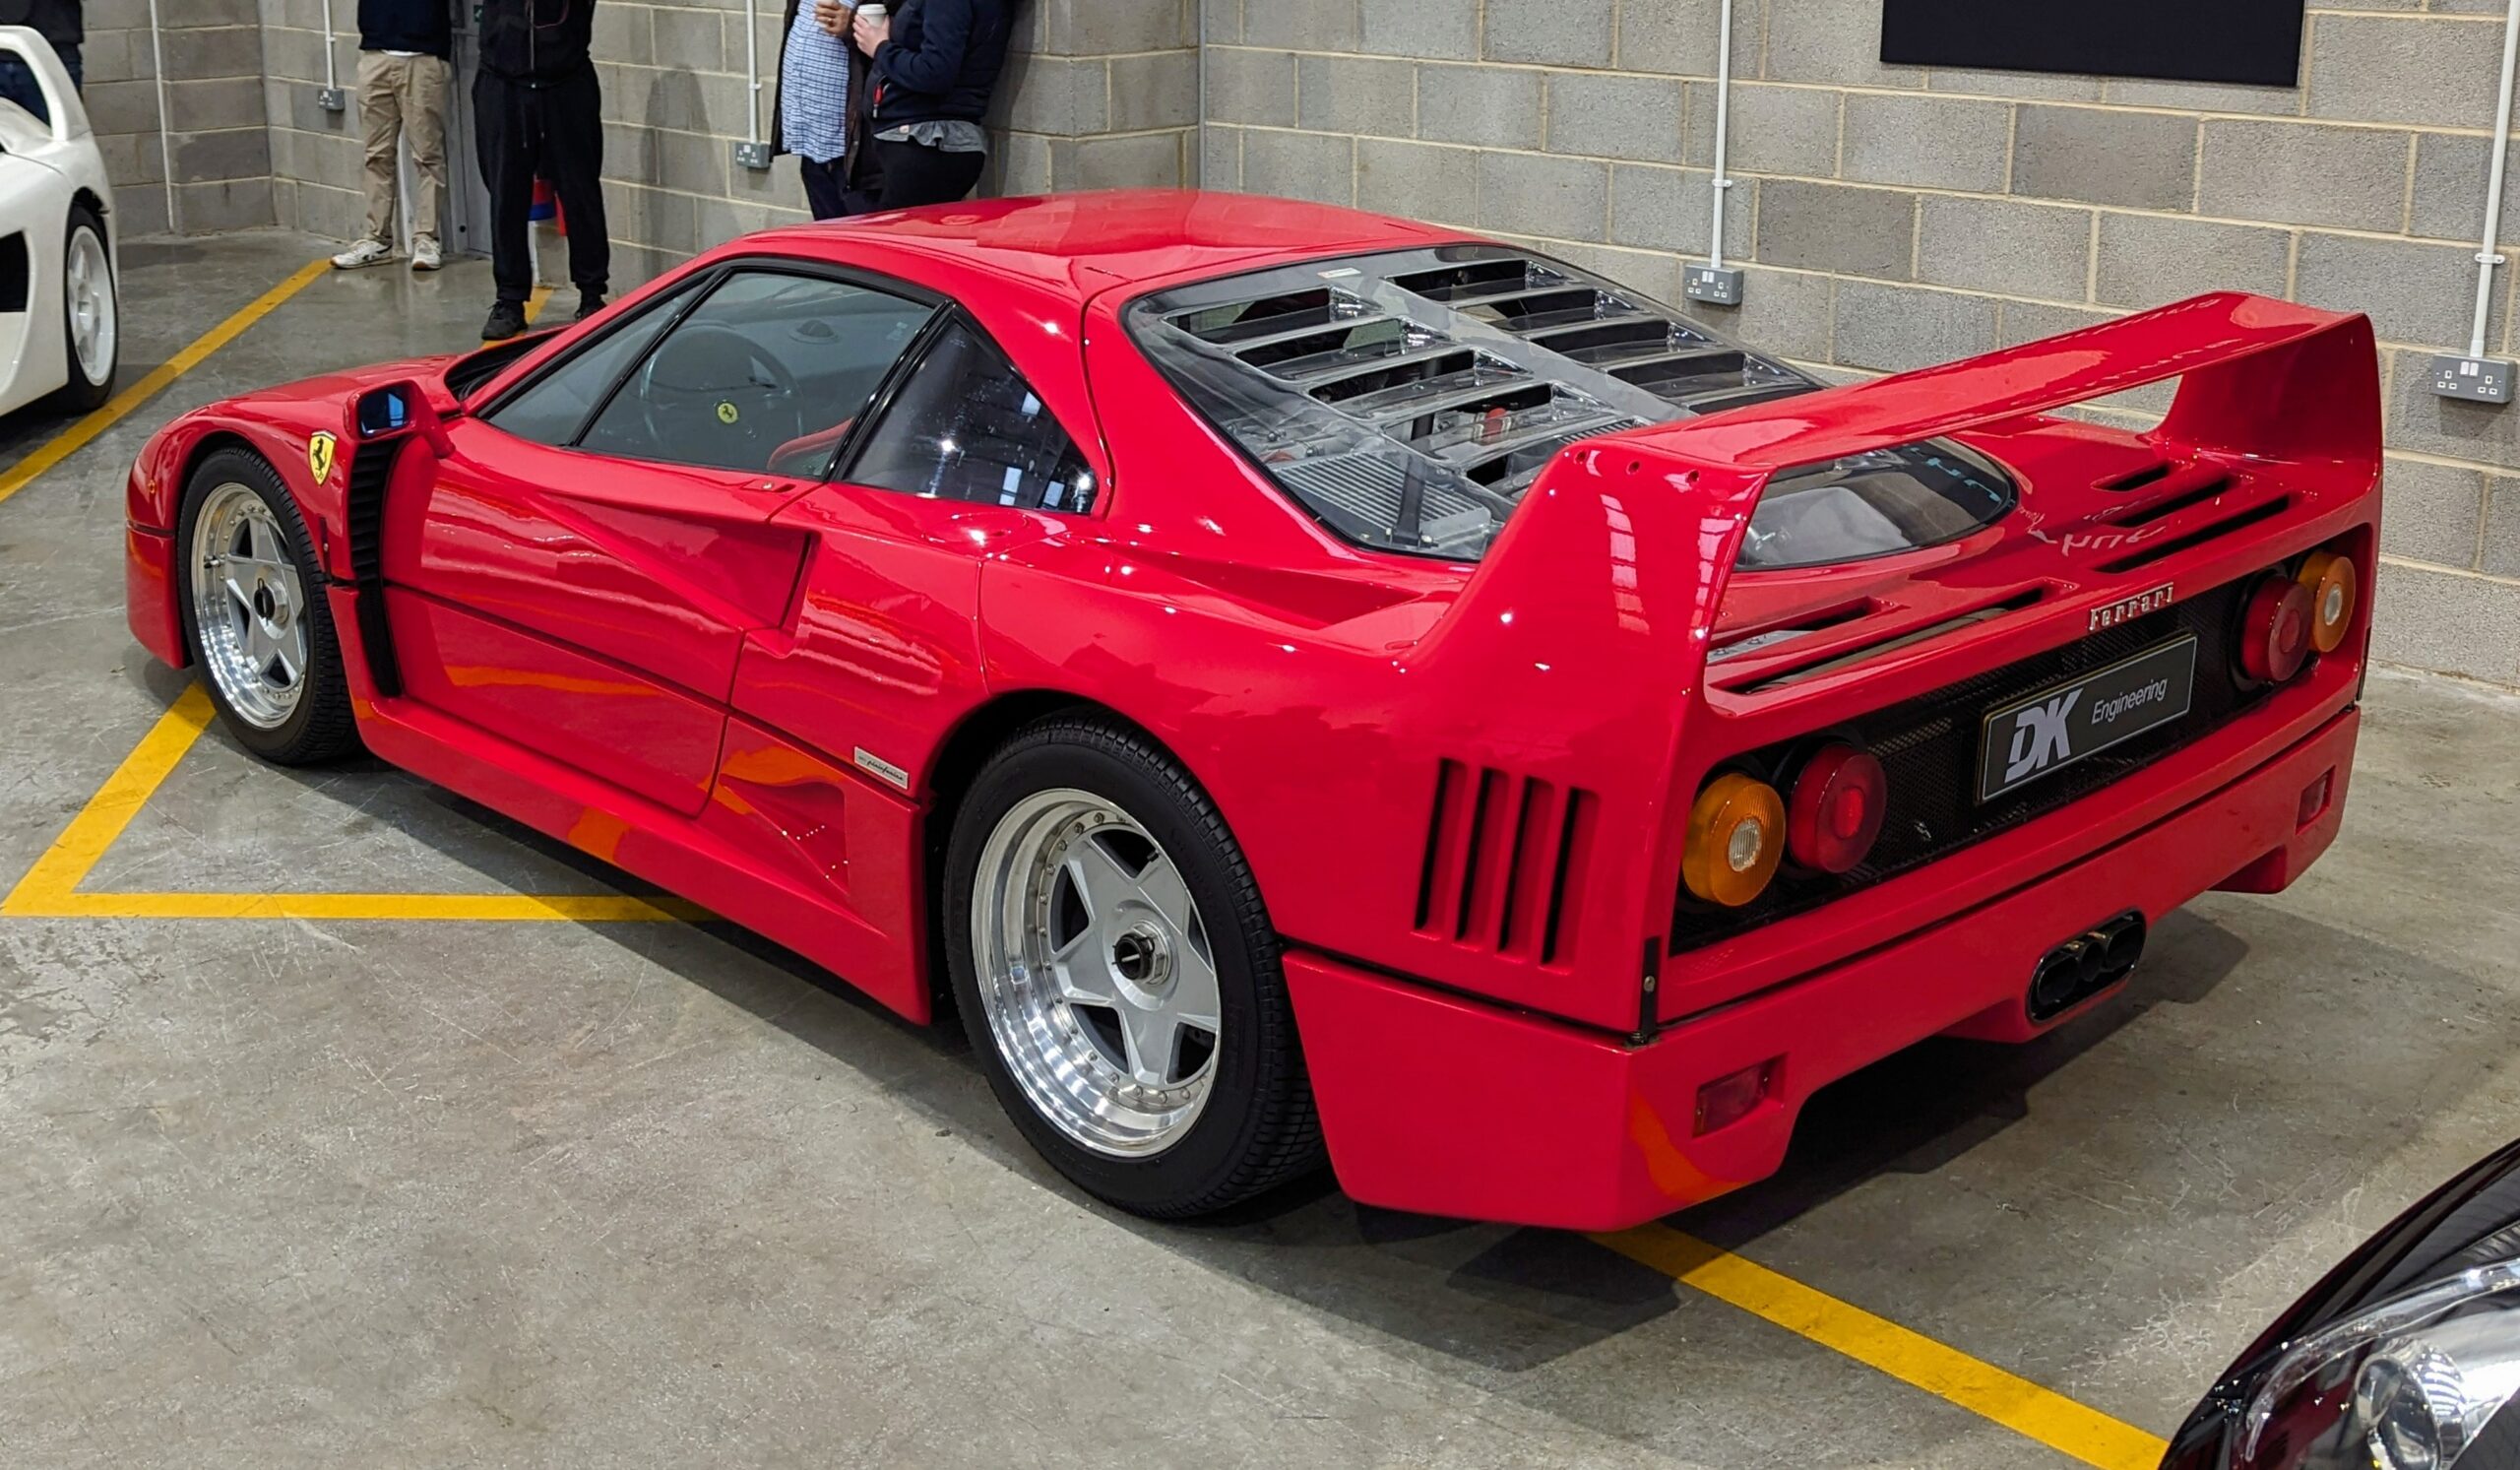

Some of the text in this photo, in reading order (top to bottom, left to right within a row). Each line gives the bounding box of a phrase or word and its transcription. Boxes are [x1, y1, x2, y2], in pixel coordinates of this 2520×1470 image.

[2088, 581, 2174, 631] Ferrari
[2004, 677, 2168, 784] DK Engineering
